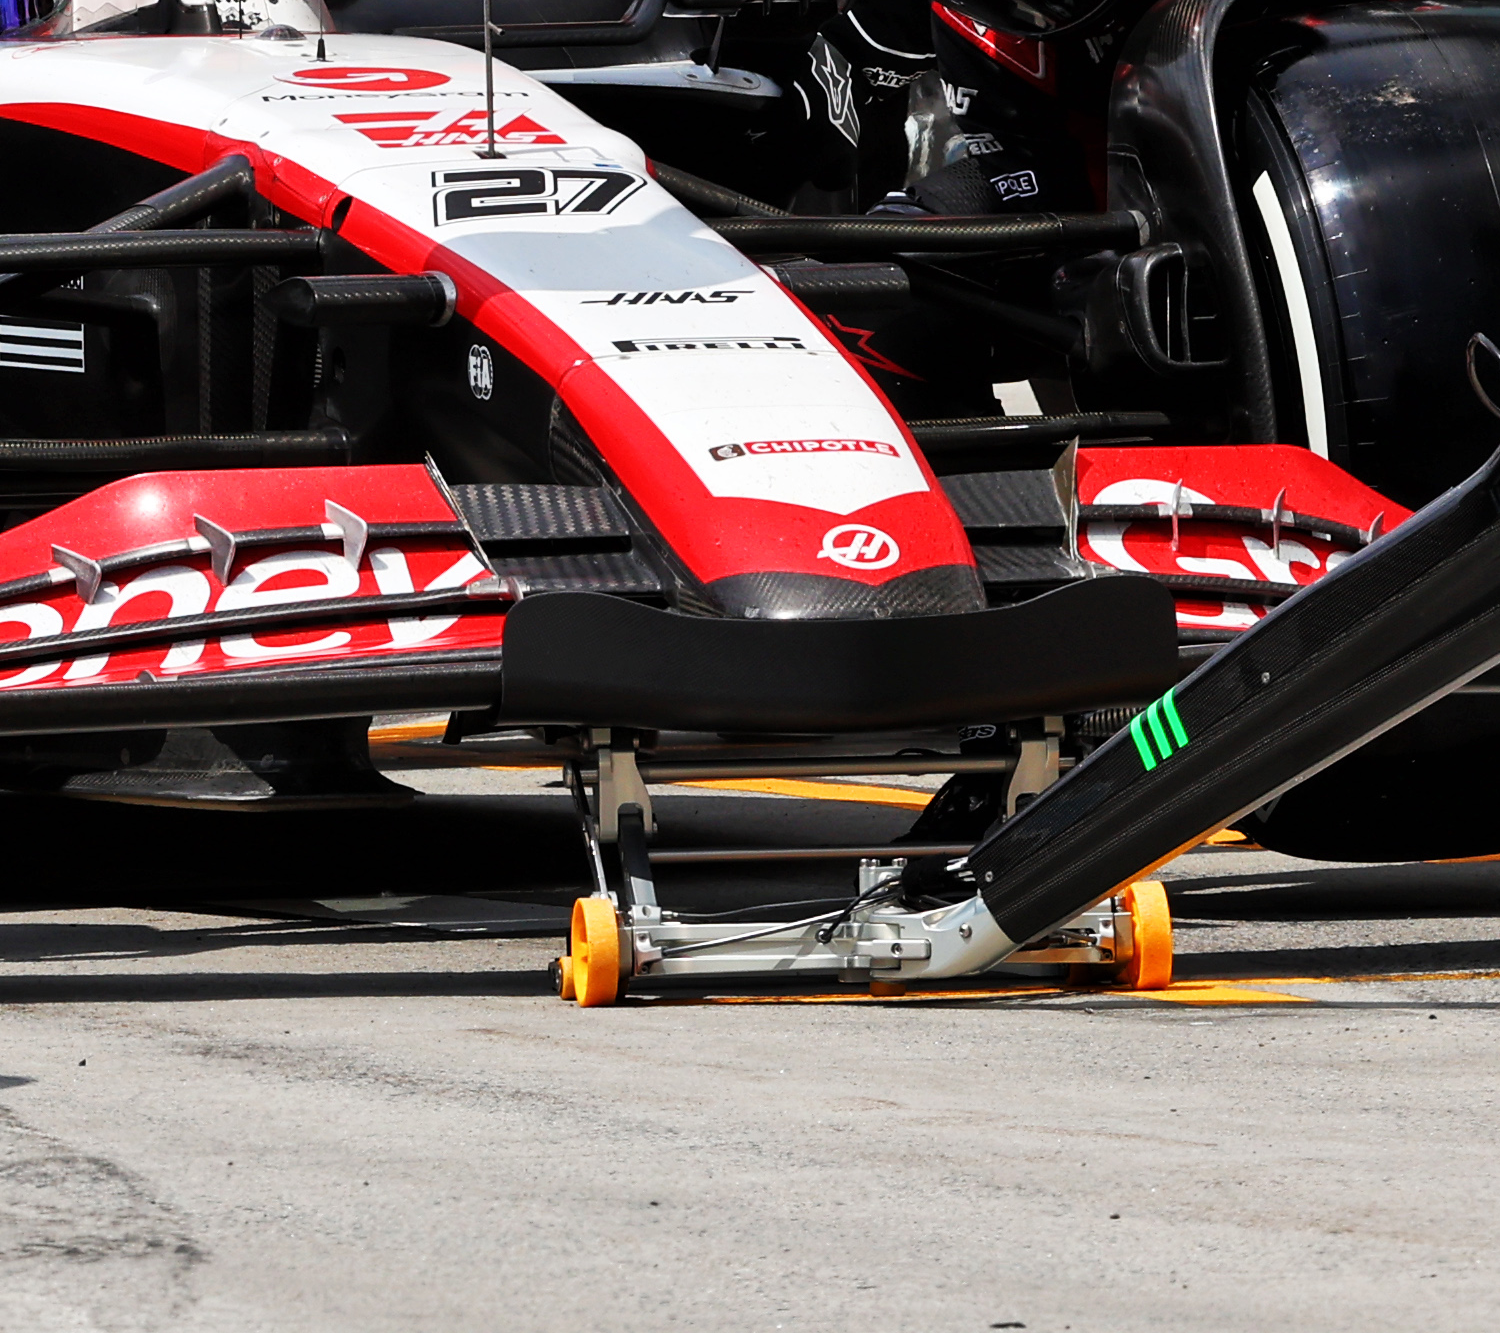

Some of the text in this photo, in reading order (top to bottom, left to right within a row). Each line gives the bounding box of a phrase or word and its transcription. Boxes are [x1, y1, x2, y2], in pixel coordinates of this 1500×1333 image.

[261, 88, 529, 106] MoneyGram
[399, 127, 560, 147] HAAS
[433, 165, 648, 227] 27
[579, 290, 755, 306] HAAS
[610, 335, 808, 353] PIRELLI
[750, 440, 895, 457] CHIPOTLE
